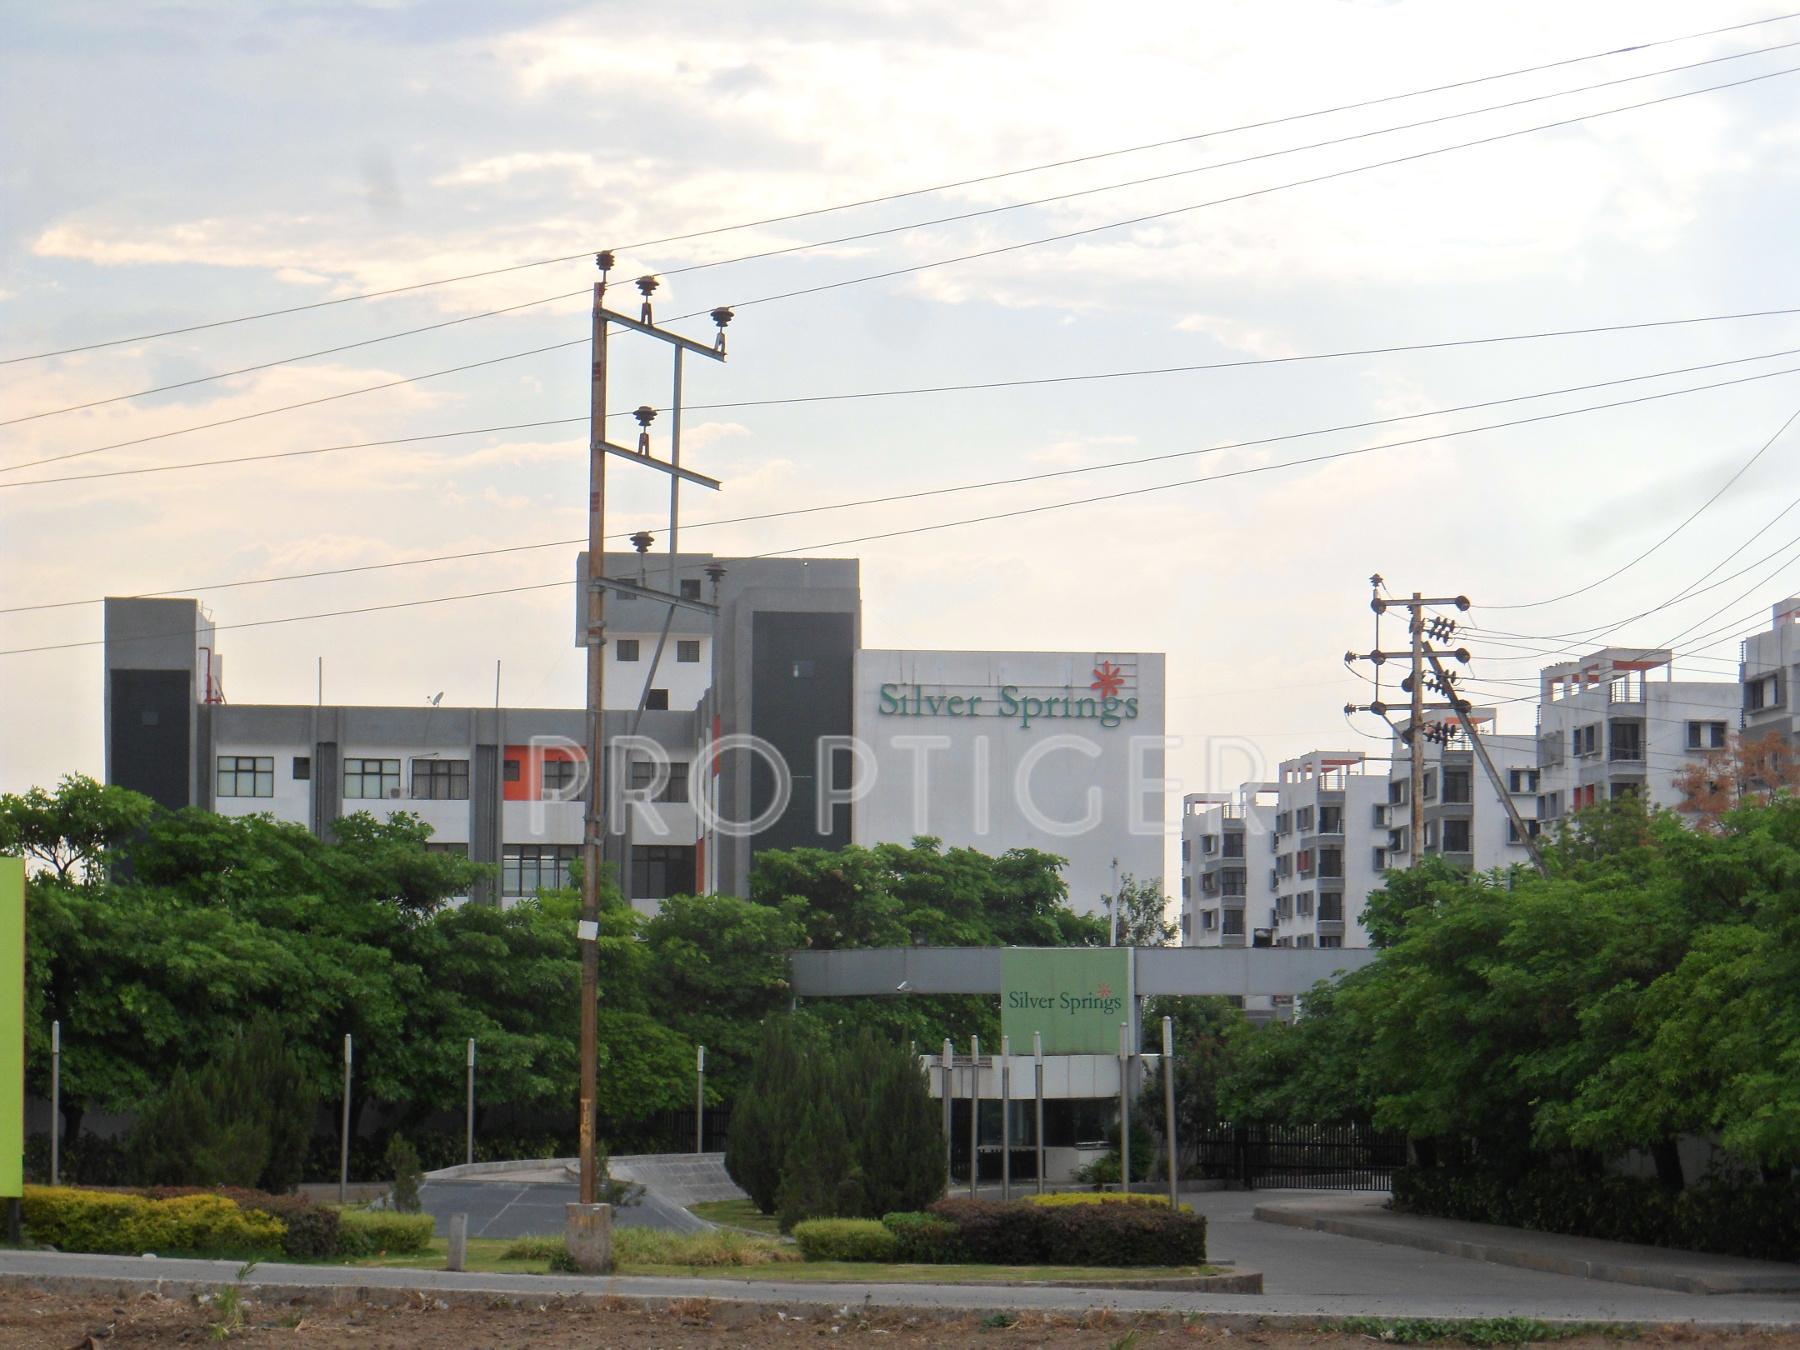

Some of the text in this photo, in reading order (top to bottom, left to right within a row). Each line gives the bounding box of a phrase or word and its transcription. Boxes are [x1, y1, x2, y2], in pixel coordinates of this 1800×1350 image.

[878, 682, 1139, 729] Silver Springs
[1008, 990, 1122, 1015] Silver Springs
